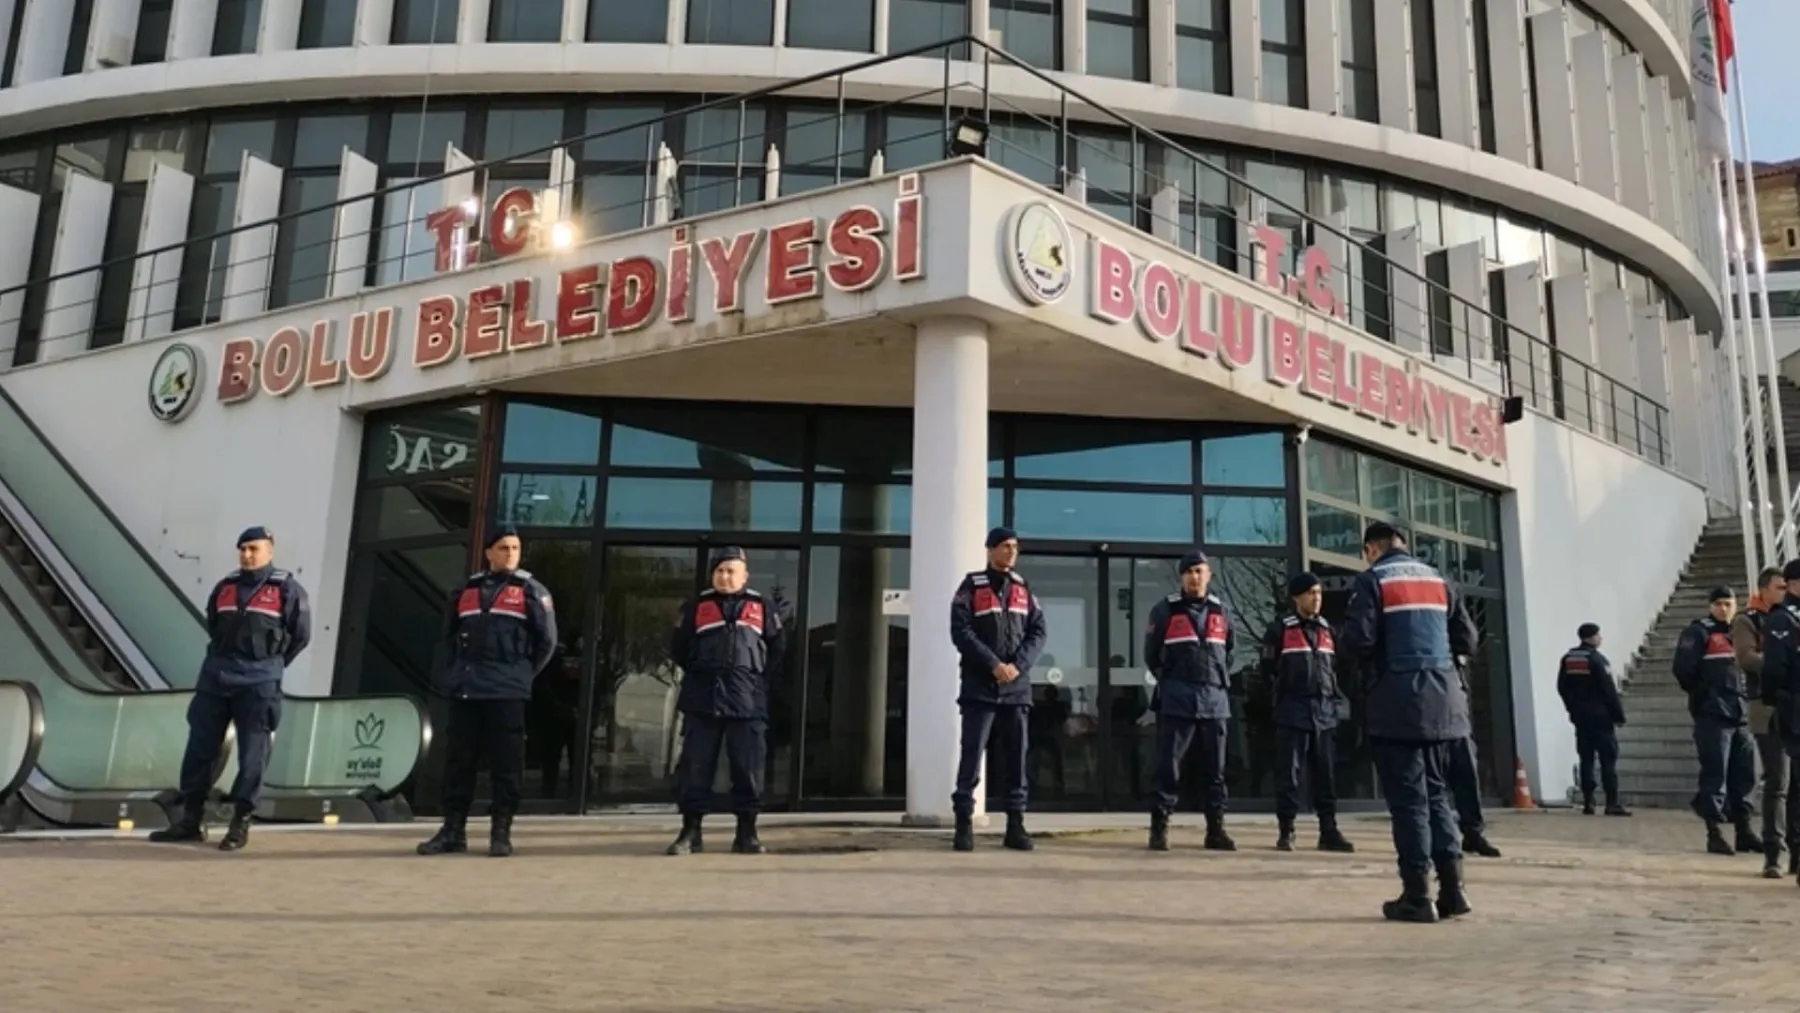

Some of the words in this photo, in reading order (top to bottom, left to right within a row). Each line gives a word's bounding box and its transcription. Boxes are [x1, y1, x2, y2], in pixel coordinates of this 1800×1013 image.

[218, 307, 394, 403] BOLU
[413, 173, 924, 368] BELEDİYESİ
[1091, 237, 1256, 368] BOLU
